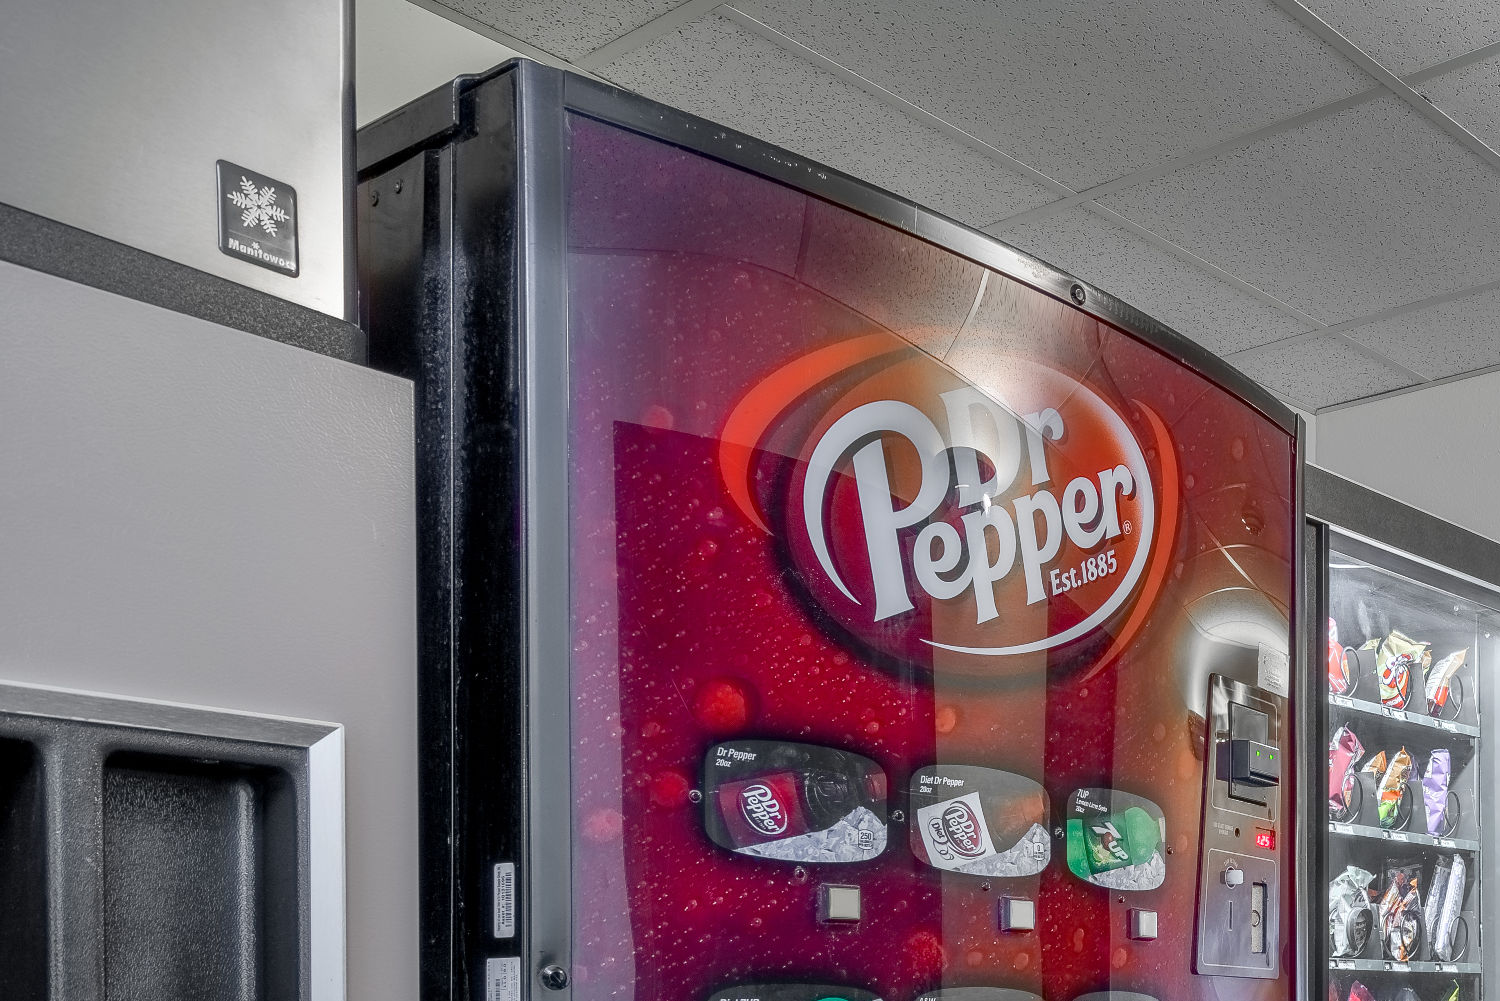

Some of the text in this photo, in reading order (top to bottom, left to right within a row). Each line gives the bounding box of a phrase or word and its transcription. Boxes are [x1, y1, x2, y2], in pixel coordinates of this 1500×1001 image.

[228, 238, 295, 271] Manitowoc
[939, 385, 1065, 509] Dr
[804, 400, 1137, 624] Pepper
[716, 759, 731, 767] 20oz
[717, 747, 756, 761] Dr Pepper
[920, 776, 965, 788] Diet Dr Pepper
[1077, 789, 1089, 799] 7UP
[742, 785, 780, 830] Pepper
[761, 798, 782, 819] Dr
[931, 821, 945, 838] Diet
[945, 807, 976, 850] Pepper
[960, 820, 977, 838] Dr
